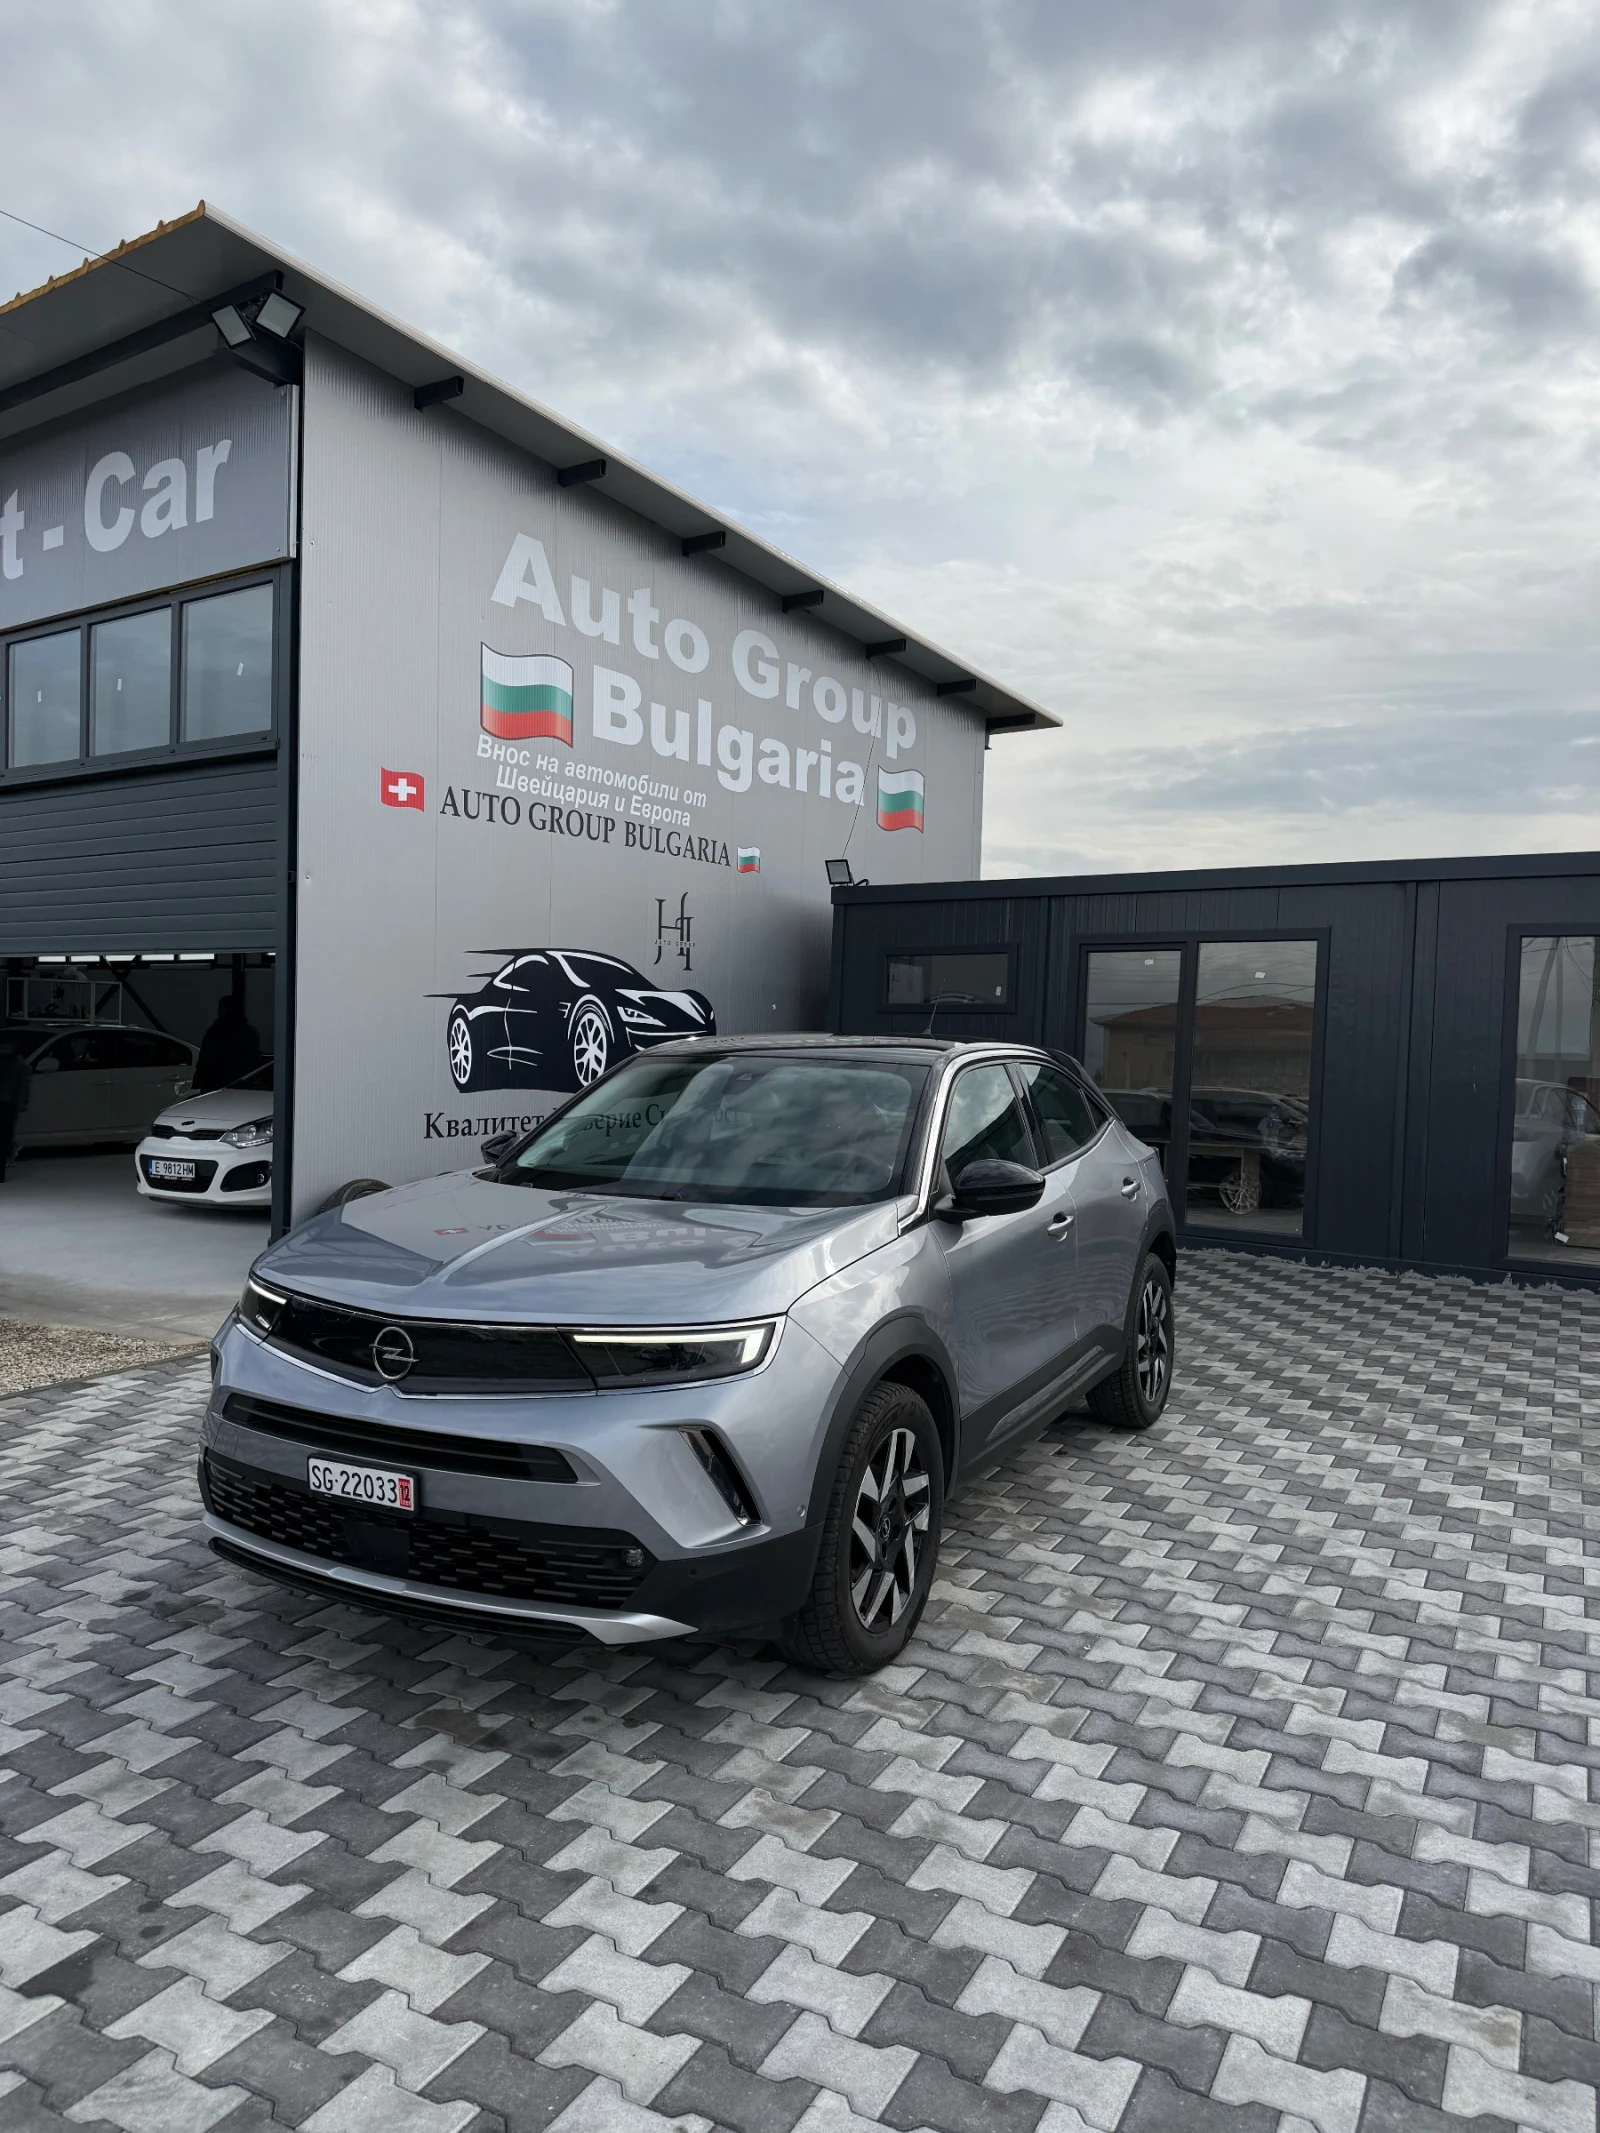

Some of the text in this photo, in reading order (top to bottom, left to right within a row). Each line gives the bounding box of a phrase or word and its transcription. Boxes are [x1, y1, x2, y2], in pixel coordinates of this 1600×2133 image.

[84, 439, 232, 552] Car
[490, 532, 917, 760] Auto Group
[477, 734, 708, 808] Внос на автомобили от
[593, 664, 865, 807] Bulgaria
[440, 786, 731, 867] AUTO GROUP BULGARIA
[496, 764, 692, 828] Швейцария и Европа
[424, 1112, 545, 1140] Квалитет
